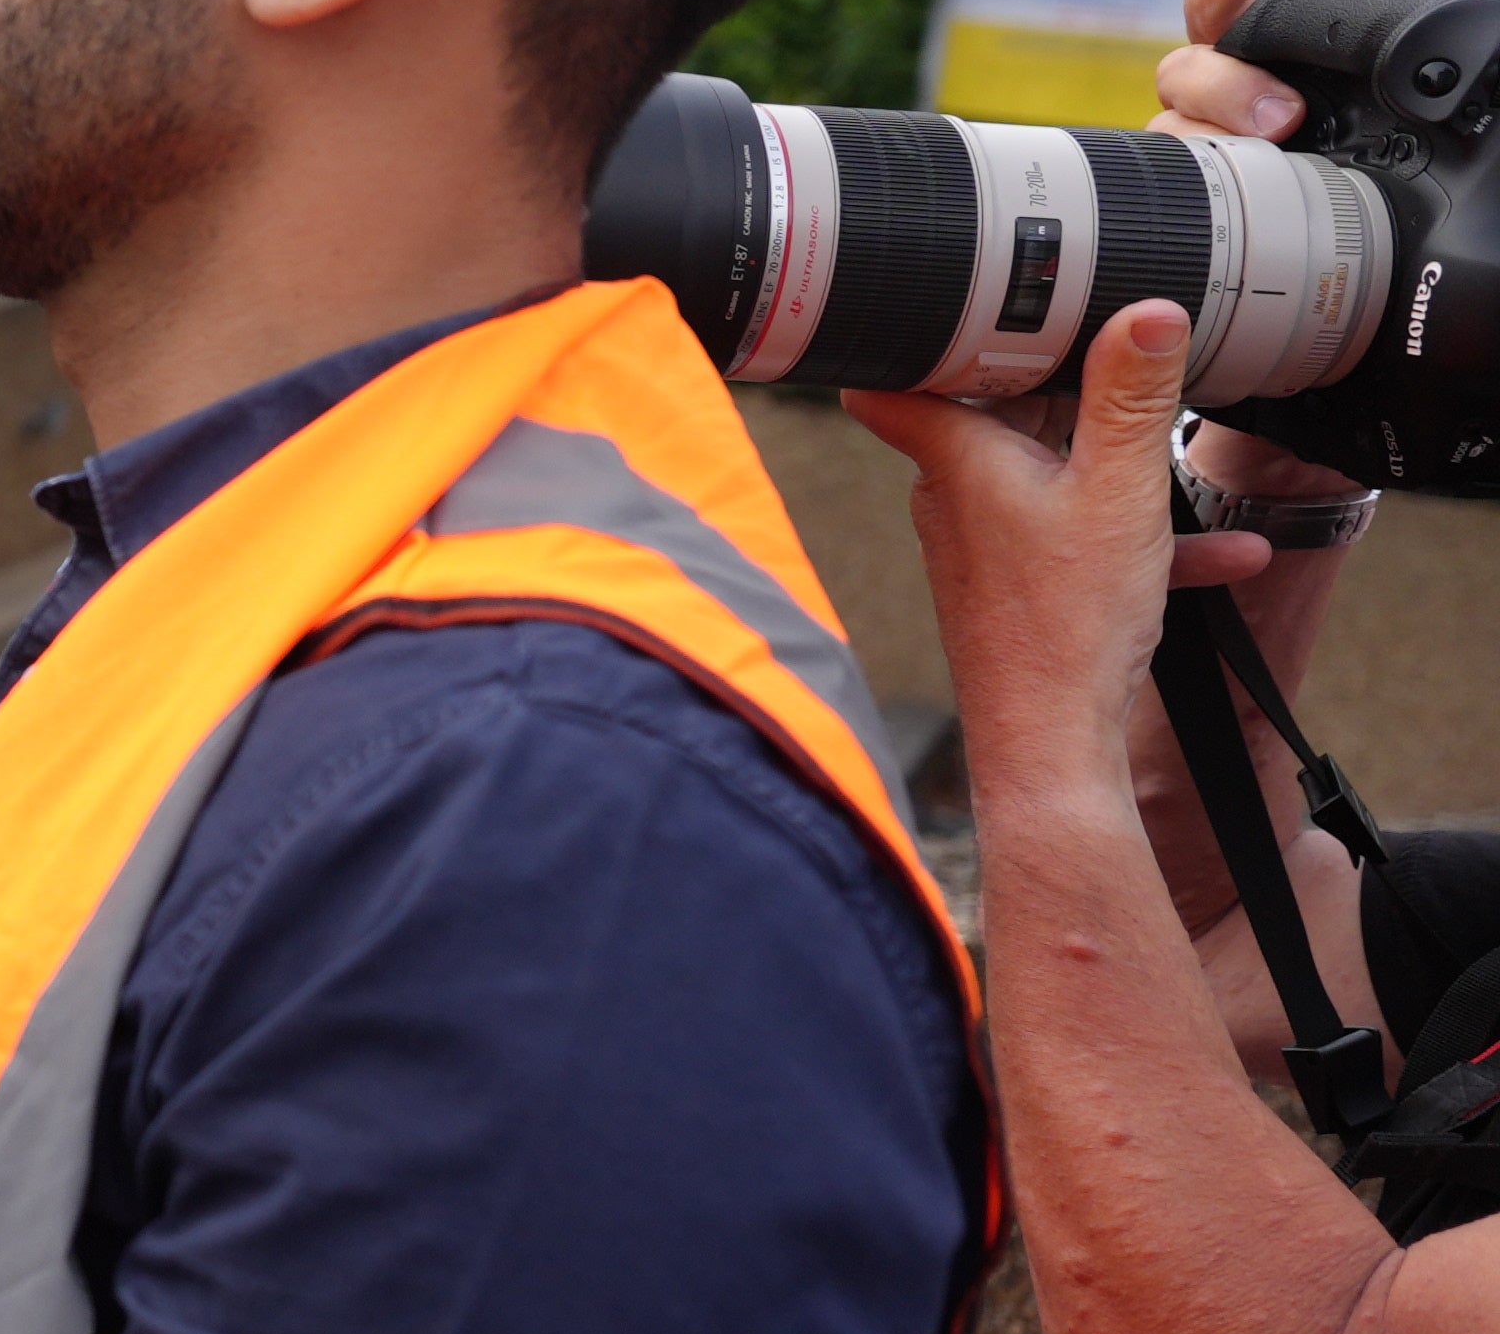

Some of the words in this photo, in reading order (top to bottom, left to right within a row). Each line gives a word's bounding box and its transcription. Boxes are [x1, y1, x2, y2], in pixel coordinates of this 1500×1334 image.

[1025, 161, 1048, 207] 70-200mm
[743, 206, 752, 236] CANON
[1216, 225, 1227, 243] 100
[731, 244, 748, 281] ET-87
[767, 219, 784, 274] 70-200mm
[800, 205, 820, 293] ULTRASONIC
[764, 283, 774, 293] EF
[1210, 280, 1222, 295] 70
[1406, 260, 1443, 357] Canon
